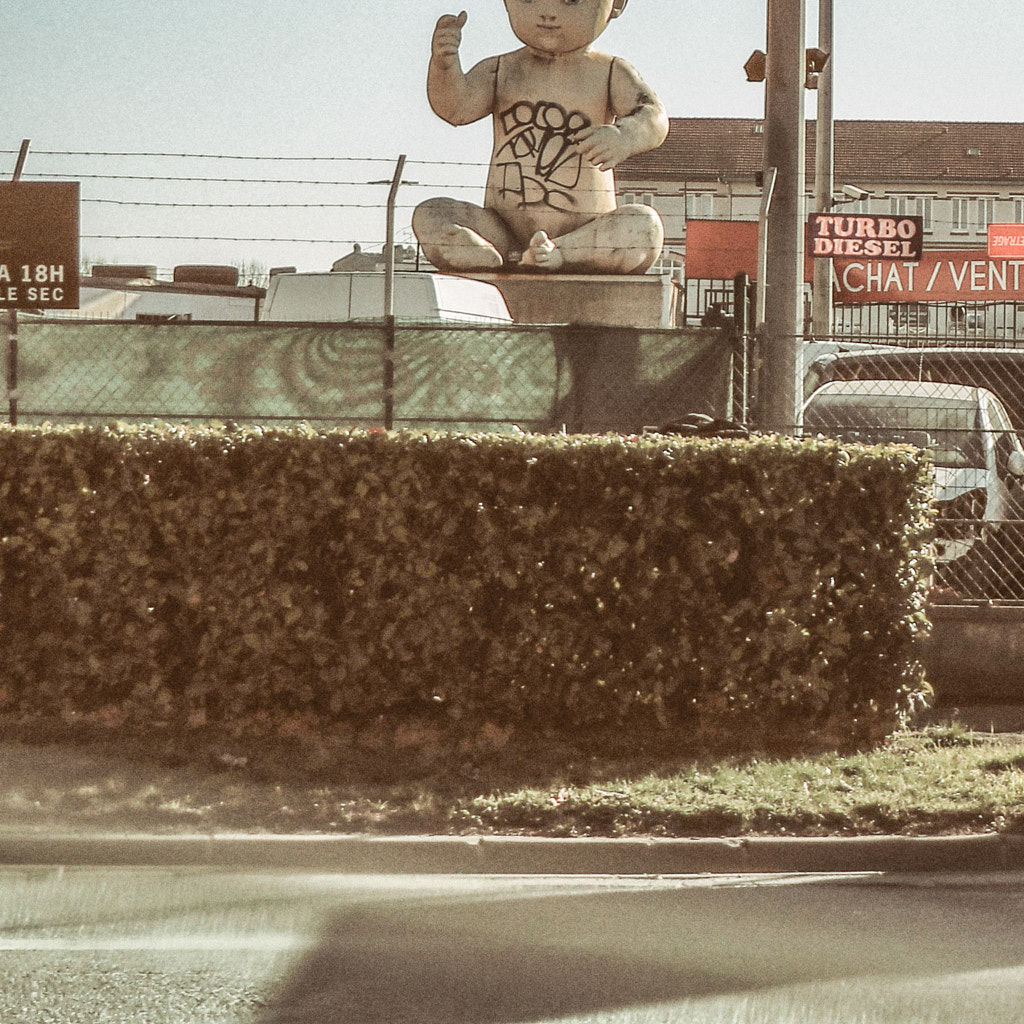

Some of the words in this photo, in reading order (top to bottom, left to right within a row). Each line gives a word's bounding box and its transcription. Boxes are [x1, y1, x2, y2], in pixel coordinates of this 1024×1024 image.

[815, 216, 917, 239] TURBO
[813, 237, 917, 257] DIESEL
[21, 264, 64, 283] 18H
[27, 287, 64, 301] SEC
